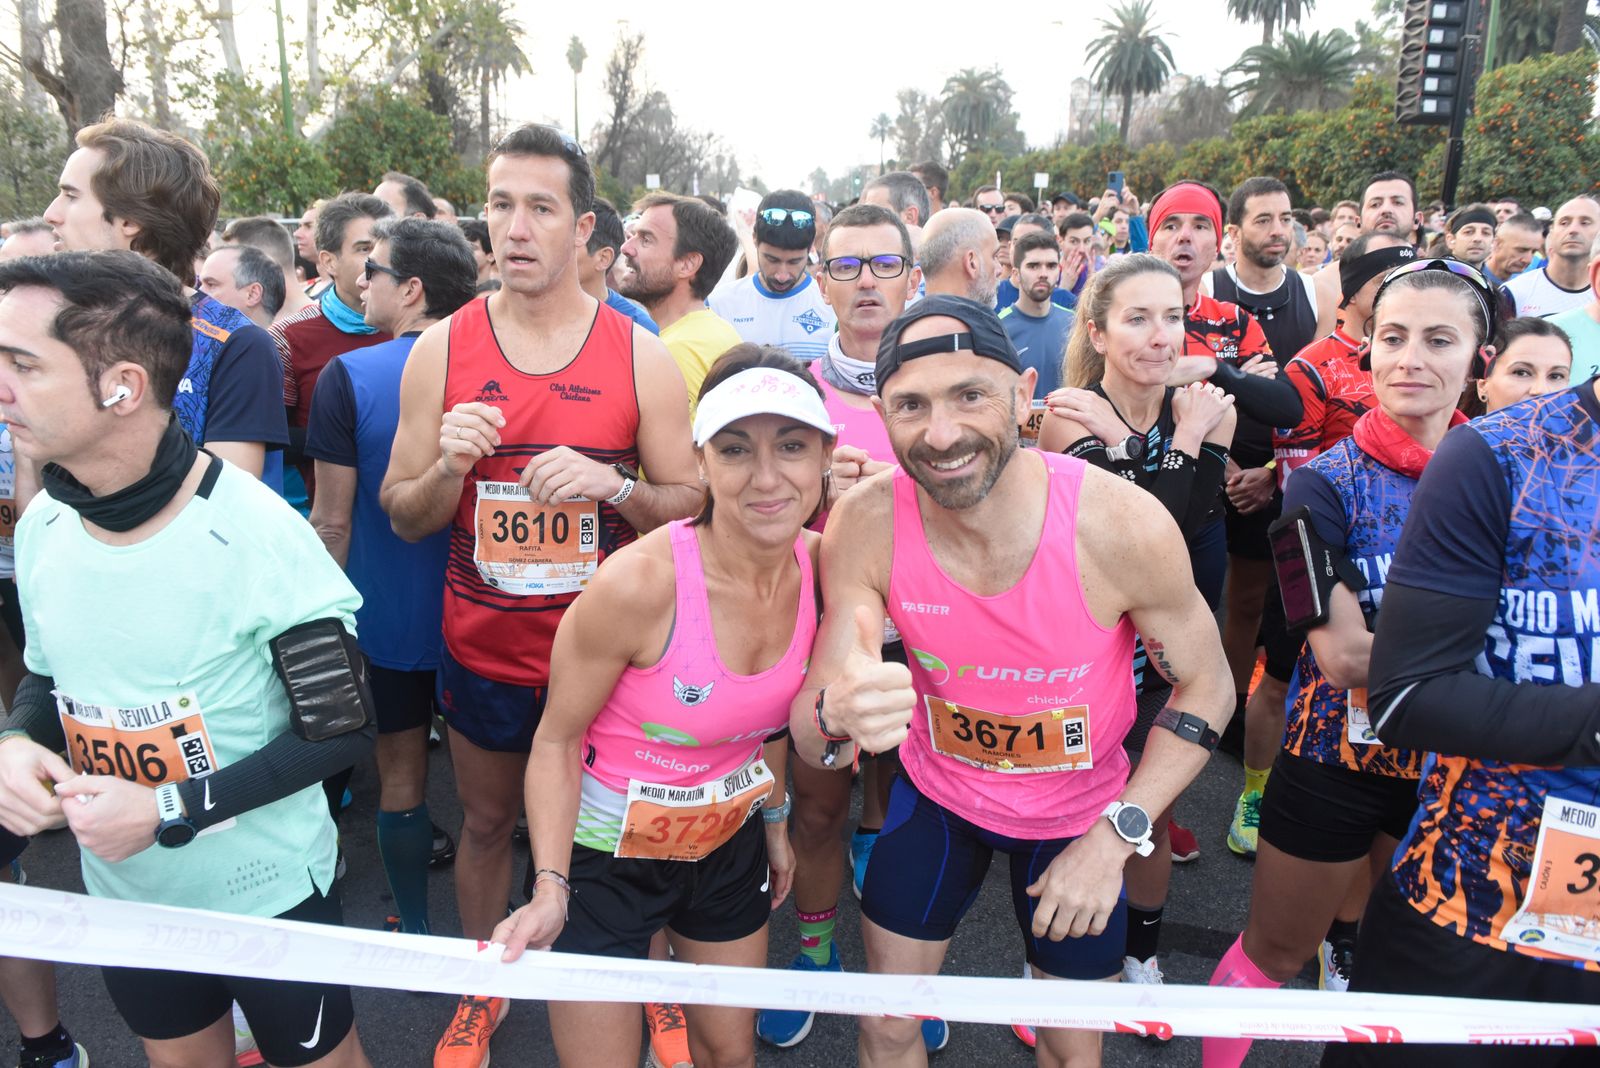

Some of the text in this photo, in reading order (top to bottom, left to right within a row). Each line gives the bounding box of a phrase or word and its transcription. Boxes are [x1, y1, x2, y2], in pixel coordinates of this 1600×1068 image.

[549, 383, 567, 393] Club
[560, 392, 591, 402] Chiclana
[485, 484, 501, 495] MEDIO
[492, 510, 569, 544] 3610
[901, 601, 950, 615] FASTER
[118, 701, 173, 728] SEVILLA
[951, 712, 1045, 752] 3671
[76, 733, 168, 783] 3506
[981, 748, 1021, 758] RAMONES
[640, 769, 754, 802] MEDIO MARATÓN SEVILLA
[647, 807, 742, 845] 3729
[1561, 806, 1597, 829] MEDIO
[227, 862, 277, 886] RUNNING
[237, 859, 261, 872] NIKE
[1567, 852, 1600, 895] 3
[229, 872, 279, 896] DIVISION
[1540, 867, 1551, 890] CAJÓN
